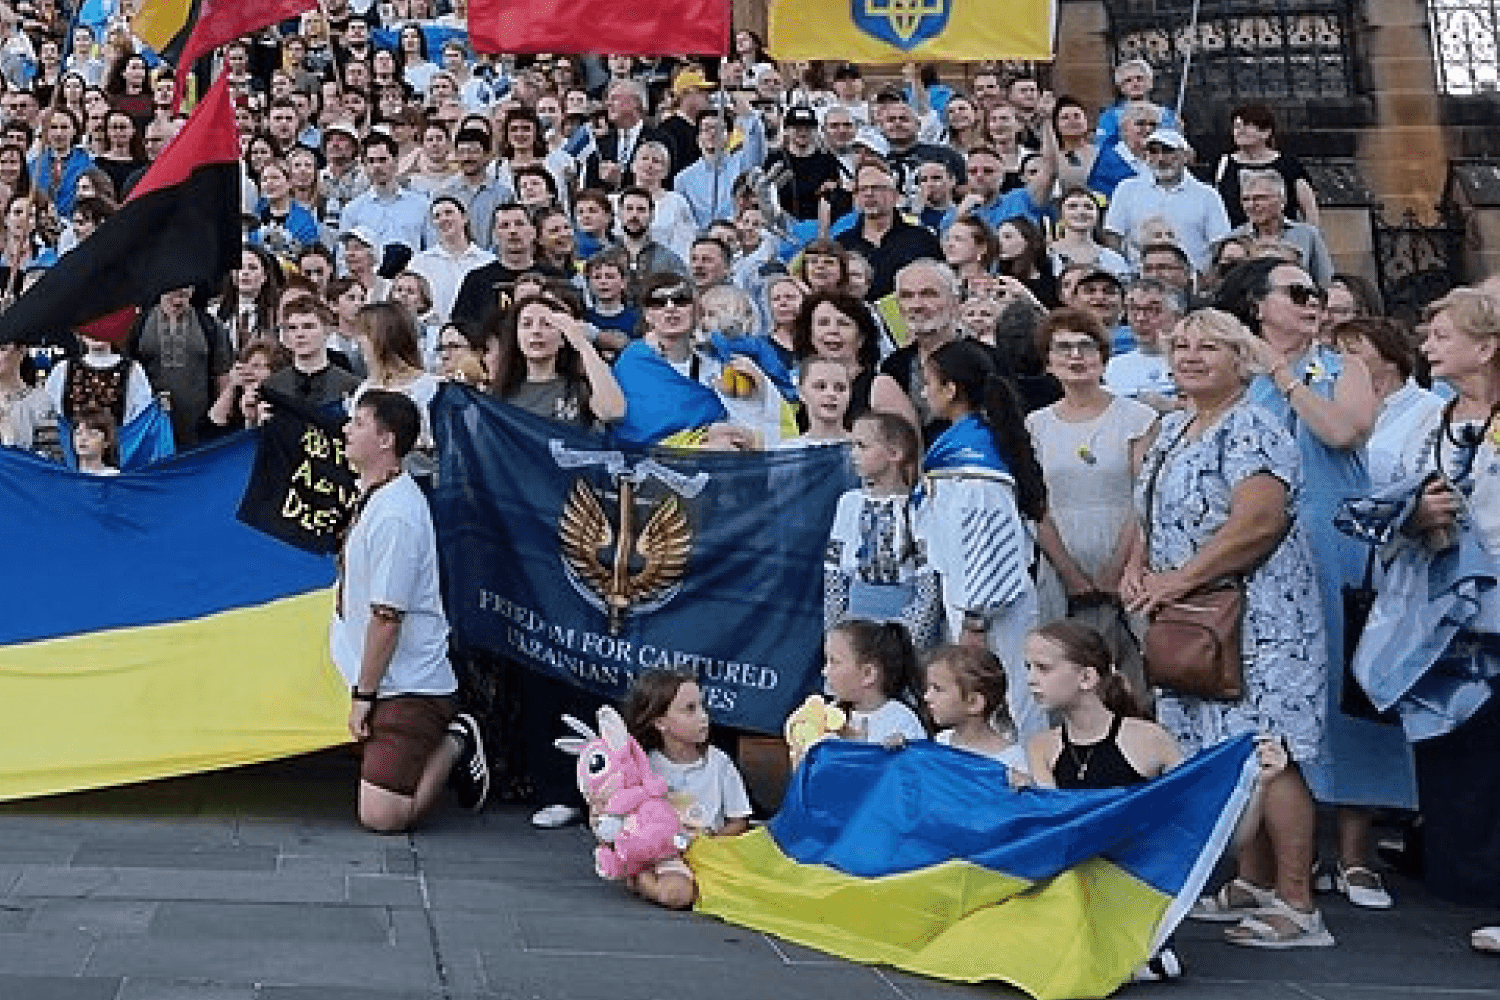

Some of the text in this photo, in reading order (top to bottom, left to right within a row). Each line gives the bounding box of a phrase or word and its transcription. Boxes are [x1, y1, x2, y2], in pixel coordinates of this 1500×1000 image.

[479, 588, 779, 690] FREEDM FOR CAPTURED
